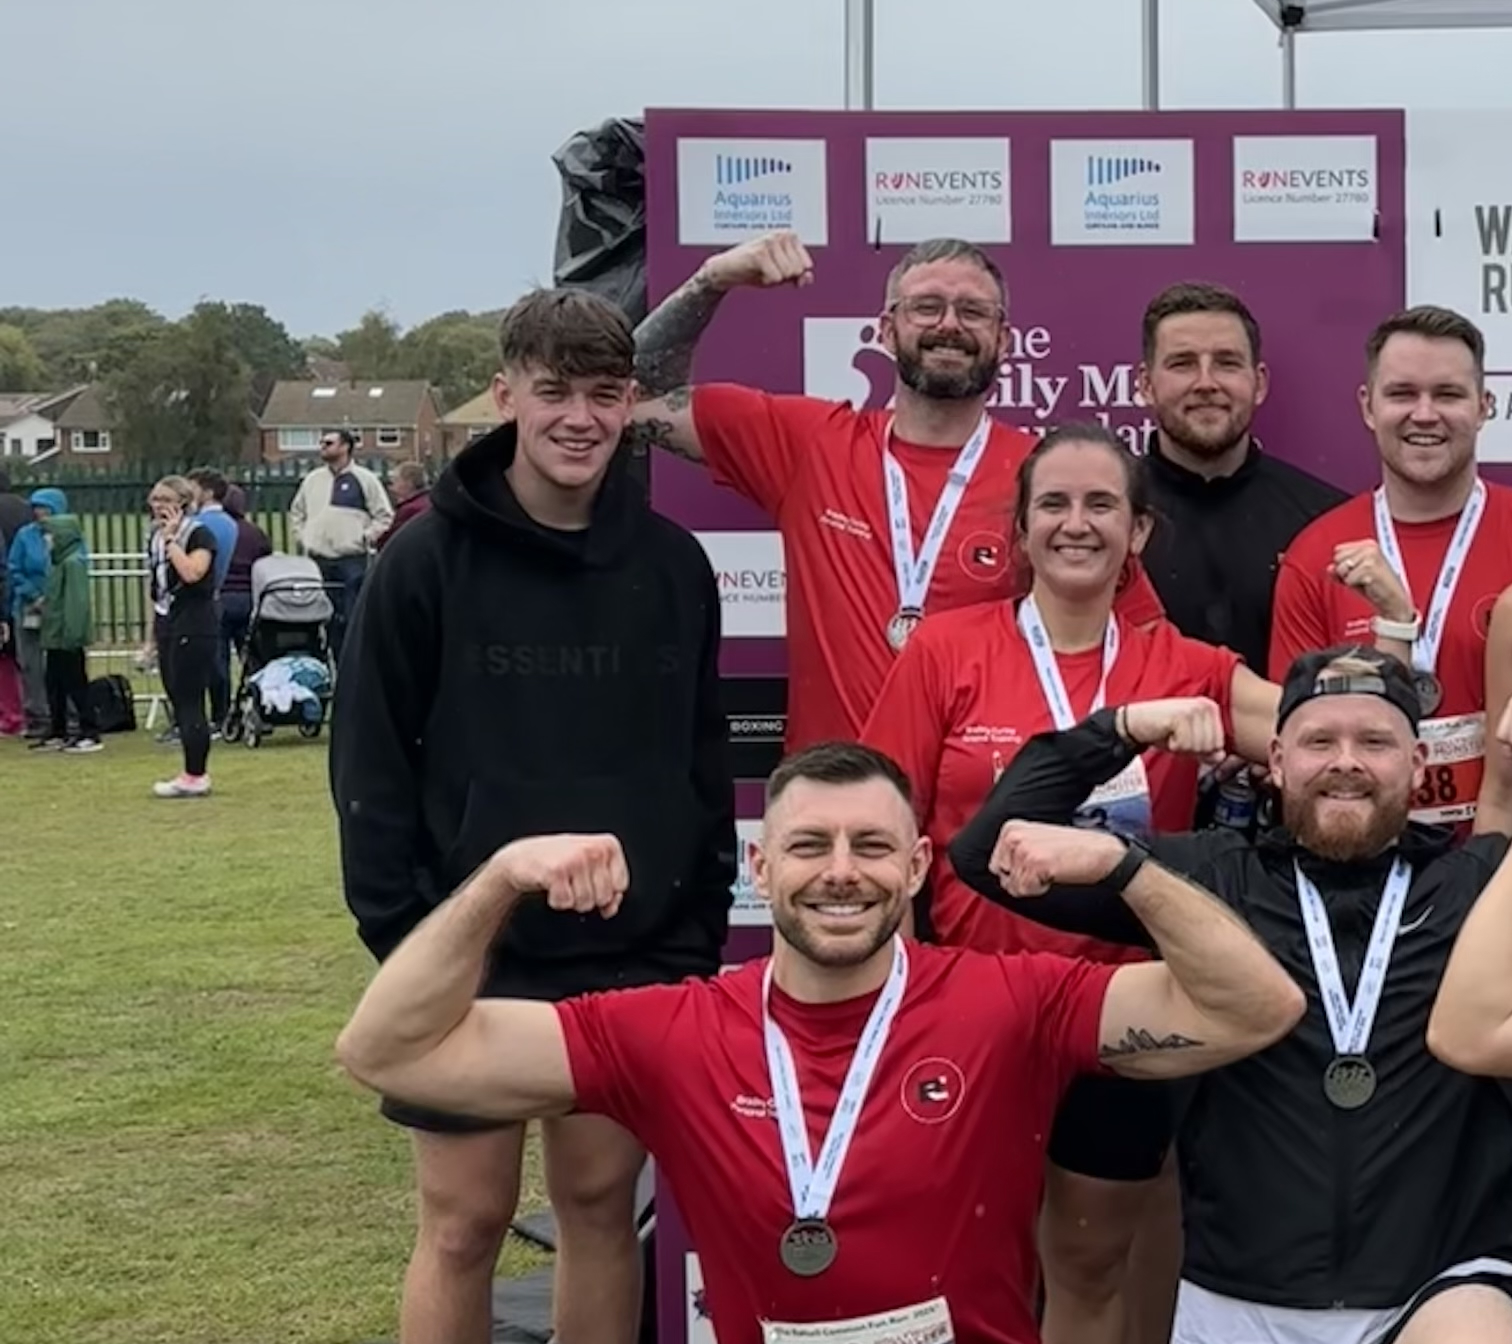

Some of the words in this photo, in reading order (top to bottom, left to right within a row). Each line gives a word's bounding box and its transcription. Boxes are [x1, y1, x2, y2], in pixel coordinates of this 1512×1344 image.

[714, 190, 792, 206] Aquarius
[919, 195, 965, 205] Number
[1085, 191, 1160, 207] Aquarius
[1286, 193, 1331, 203] Number
[985, 363, 1069, 419] ily
[730, 721, 784, 731] BOXING
